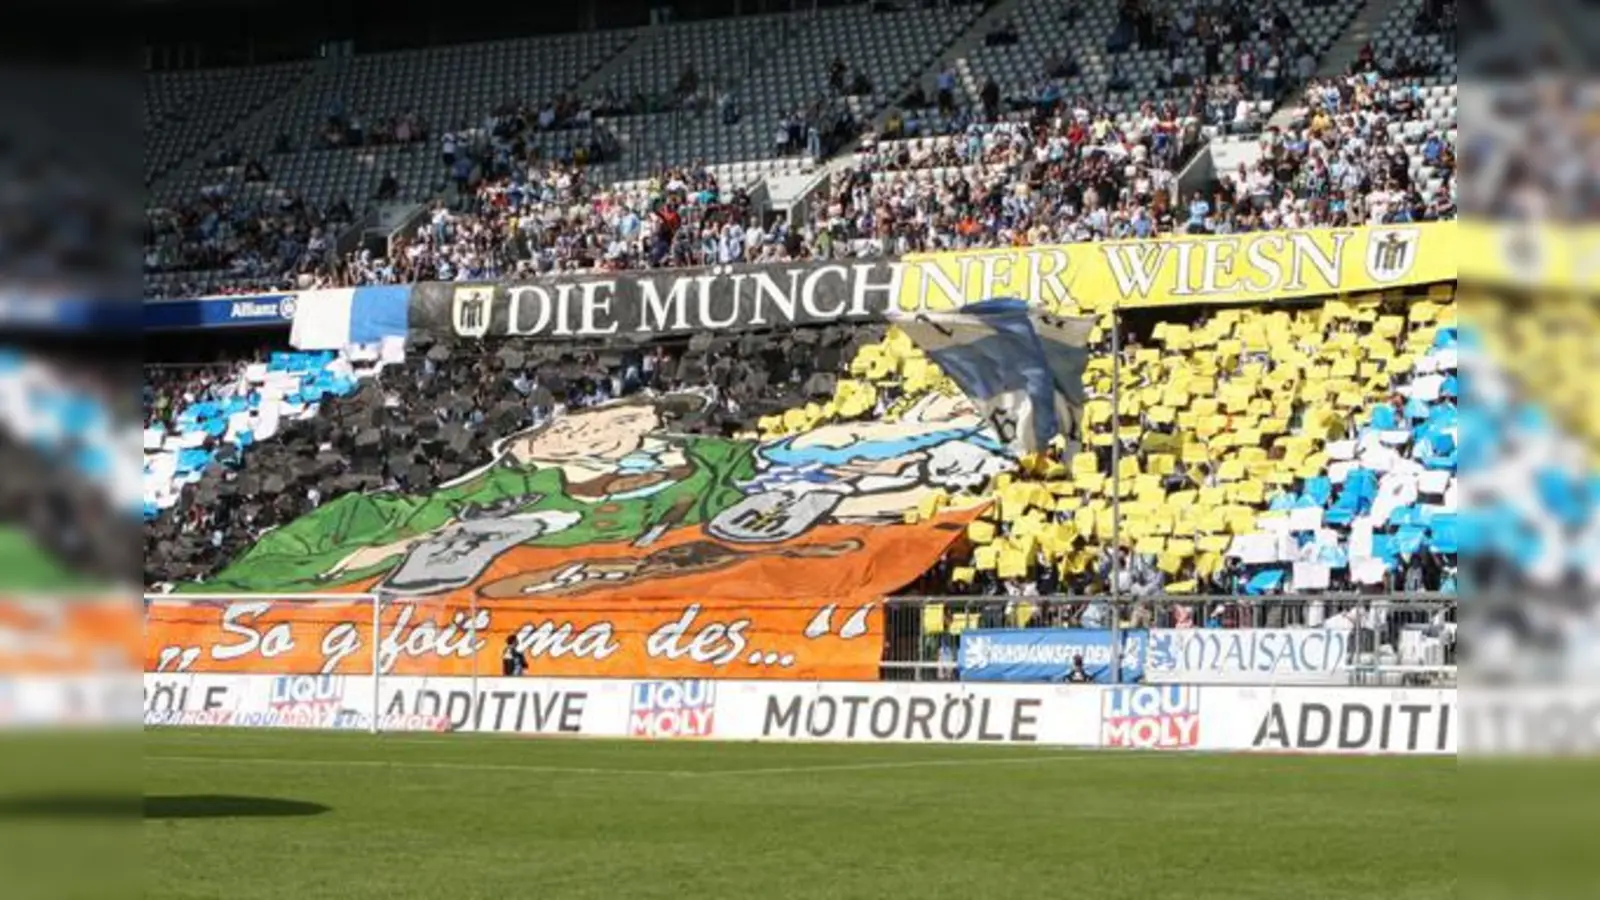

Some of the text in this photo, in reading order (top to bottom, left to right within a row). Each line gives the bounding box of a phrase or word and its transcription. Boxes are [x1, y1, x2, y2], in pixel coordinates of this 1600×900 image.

[506, 231, 1354, 336] DIE MÜNCHNER WIESN
[230, 302, 278, 318] Allianz
[516, 620, 619, 660] ma
[273, 676, 344, 702] LIQUI
[632, 680, 716, 709] LIQUI
[1102, 686, 1200, 716] LIQUI
[386, 688, 588, 732] ADDITIVE
[629, 708, 715, 736] MOLY
[762, 694, 1042, 741] MOTORÖLE
[1102, 716, 1199, 747] MOLY
